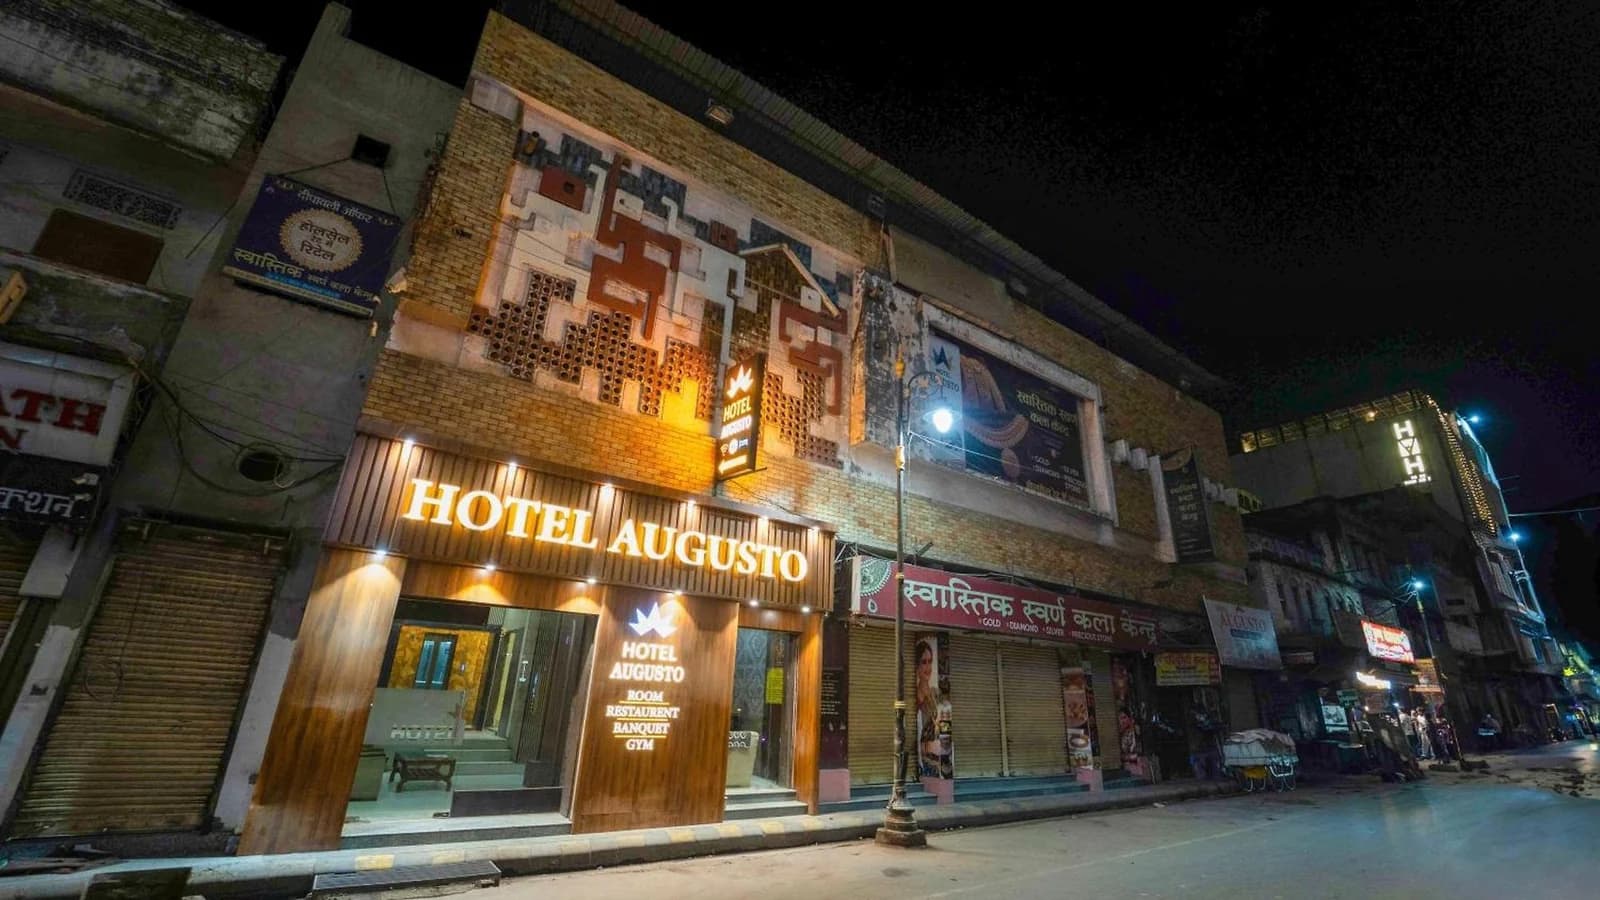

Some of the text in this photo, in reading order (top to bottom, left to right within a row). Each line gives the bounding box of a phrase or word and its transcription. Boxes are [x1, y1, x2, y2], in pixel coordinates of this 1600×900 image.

[299, 219, 350, 245] होलसेल
[300, 240, 336, 261] रिटेल
[234, 248, 305, 279] स्वास्तिक
[723, 396, 752, 422] HOTEL
[402, 478, 809, 582] HOTEL AUGUSTO
[904, 577, 1158, 646] स्वास्तिक स्वर्ण कला केन्द्र
[983, 617, 1001, 628] GOLD
[1009, 620, 1039, 634] DIAMOND
[622, 641, 678, 662] HOTEL
[609, 662, 686, 682] AUGUSTO
[627, 690, 664, 702] ROOM
[605, 704, 681, 719] RESTAURENT
[612, 721, 671, 736] BANQUET
[626, 738, 654, 751] GYM
